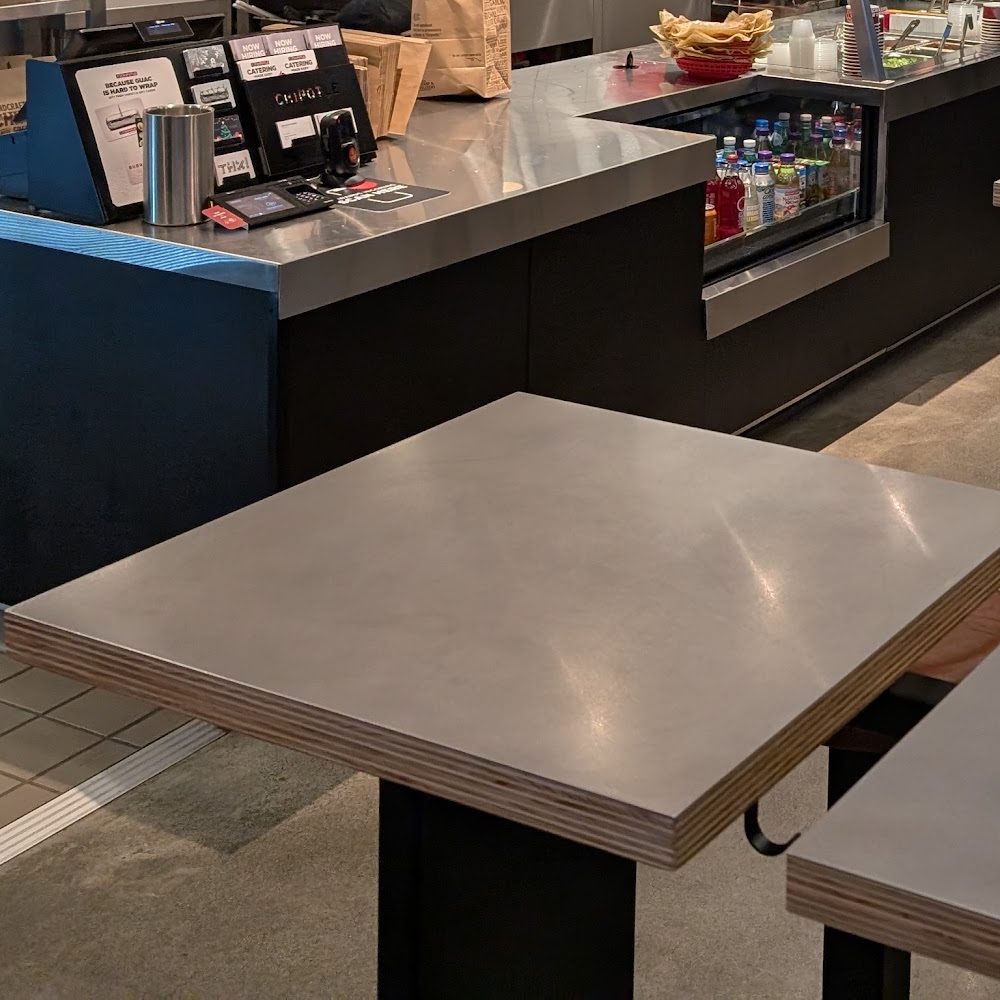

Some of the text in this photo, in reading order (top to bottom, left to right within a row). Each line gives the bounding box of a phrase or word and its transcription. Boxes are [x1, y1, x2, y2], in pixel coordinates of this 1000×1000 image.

[314, 32, 332, 41] NOW
[242, 42, 260, 52] NOW
[274, 38, 292, 47] NOW
[314, 40, 337, 48] HIRING
[241, 50, 266, 60] HIRING
[273, 45, 298, 55] HIRING
[284, 60, 313, 69] CATERING
[246, 65, 278, 76] CATERING
[104, 76, 152, 89] BECAUSE GUAC
[110, 86, 128, 95] HARD
[138, 82, 158, 90] WRAP
